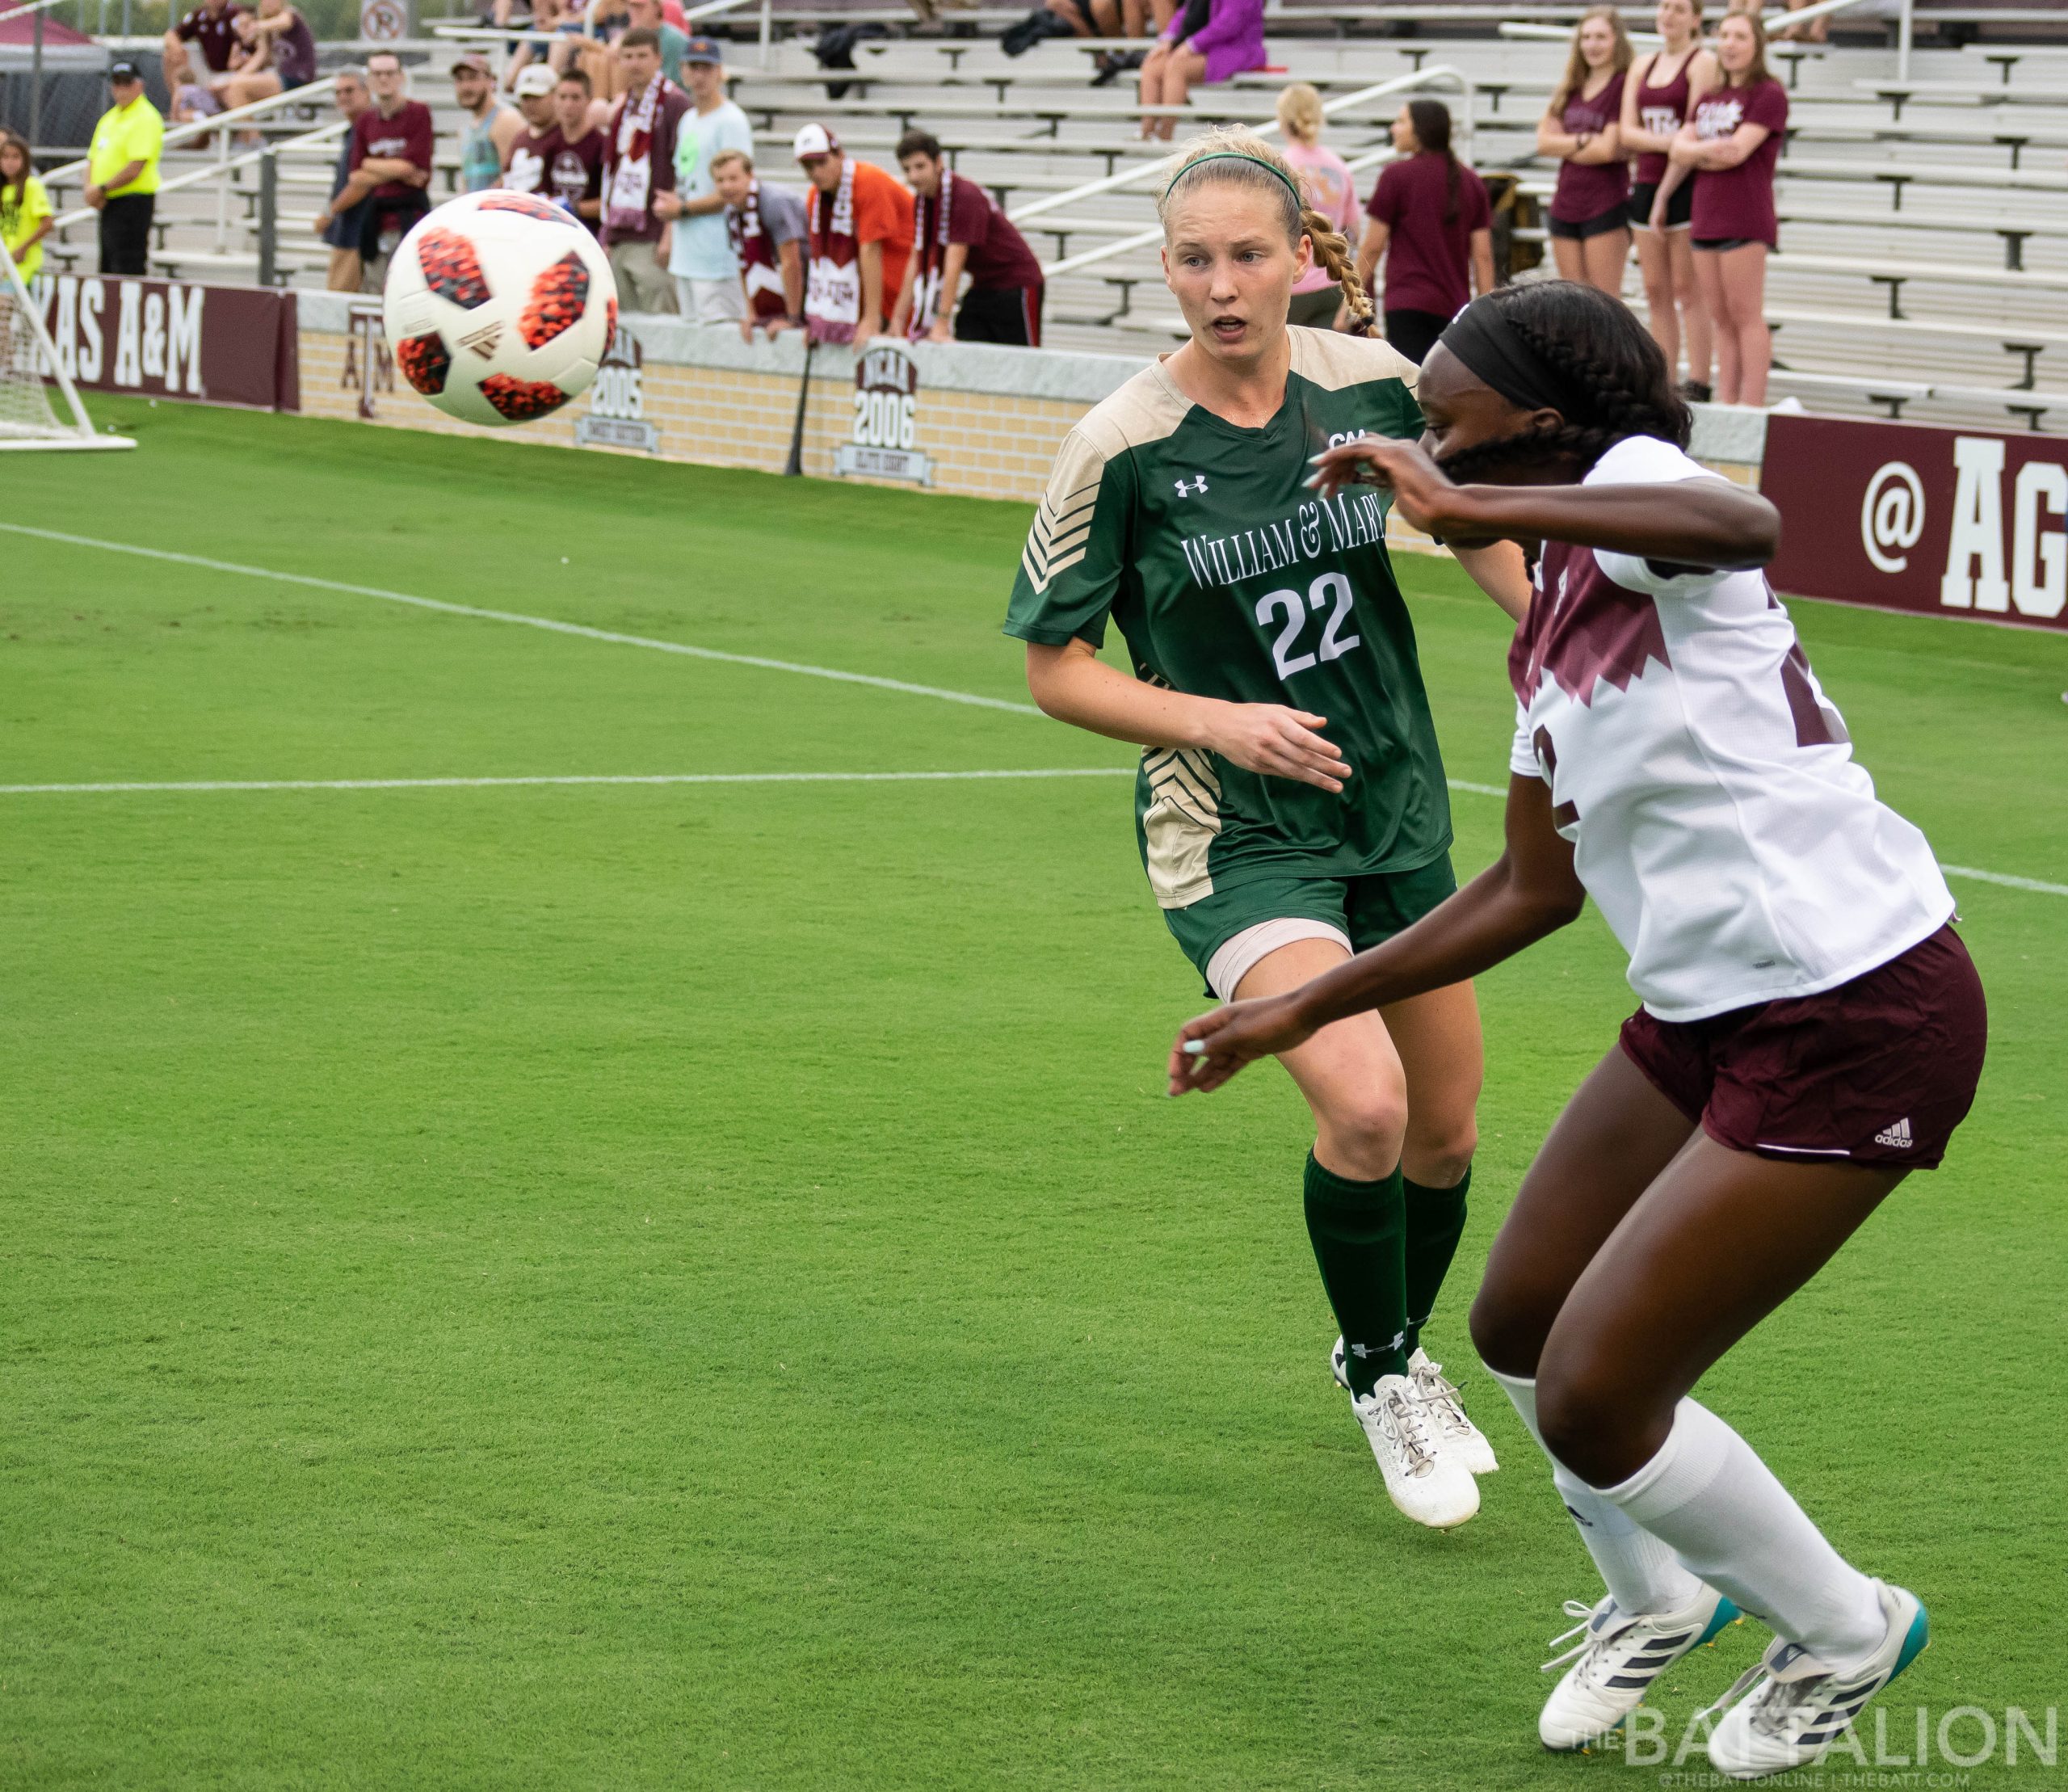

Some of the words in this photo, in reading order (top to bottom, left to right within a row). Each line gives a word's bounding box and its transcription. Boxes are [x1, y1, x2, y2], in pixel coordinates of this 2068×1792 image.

[114, 280, 205, 394] A&M
[592, 366, 642, 419] 2005
[854, 389, 915, 449] 2006
[1180, 519, 1300, 591] WILLIAM
[1299, 502, 1321, 558] &
[1320, 493, 1385, 553] MARY
[1255, 572, 1360, 681] 22
[1874, 1134, 1913, 1147] adidas
